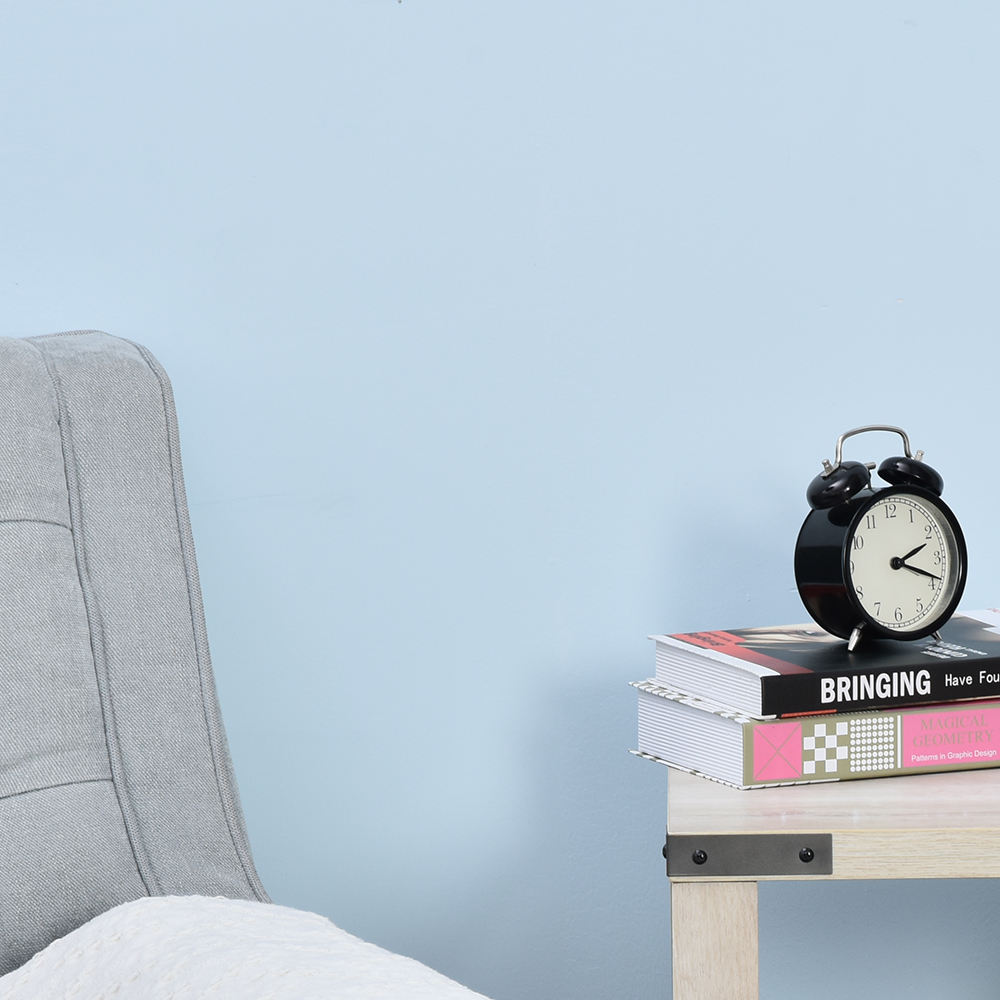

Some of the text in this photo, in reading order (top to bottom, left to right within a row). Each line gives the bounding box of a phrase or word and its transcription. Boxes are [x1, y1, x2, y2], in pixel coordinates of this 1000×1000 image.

[884, 504, 897, 519] 12
[909, 509, 914, 523] 1
[866, 515, 877, 529] 11
[924, 525, 932, 539] 2
[853, 535, 864, 550] 10
[933, 550, 941, 565] 3
[928, 576, 936, 590] 4
[856, 585, 864, 600] 8
[874, 602, 881, 616] 7
[916, 598, 924, 613] 5
[894, 607, 903, 622] 6
[820, 669, 931, 704] BRINGING
[945, 673, 973, 688] Have
[920, 713, 989, 731] MAGICAL
[913, 728, 994, 748] GEOMETRY
[911, 748, 997, 762] Patterns in Graphic Design
